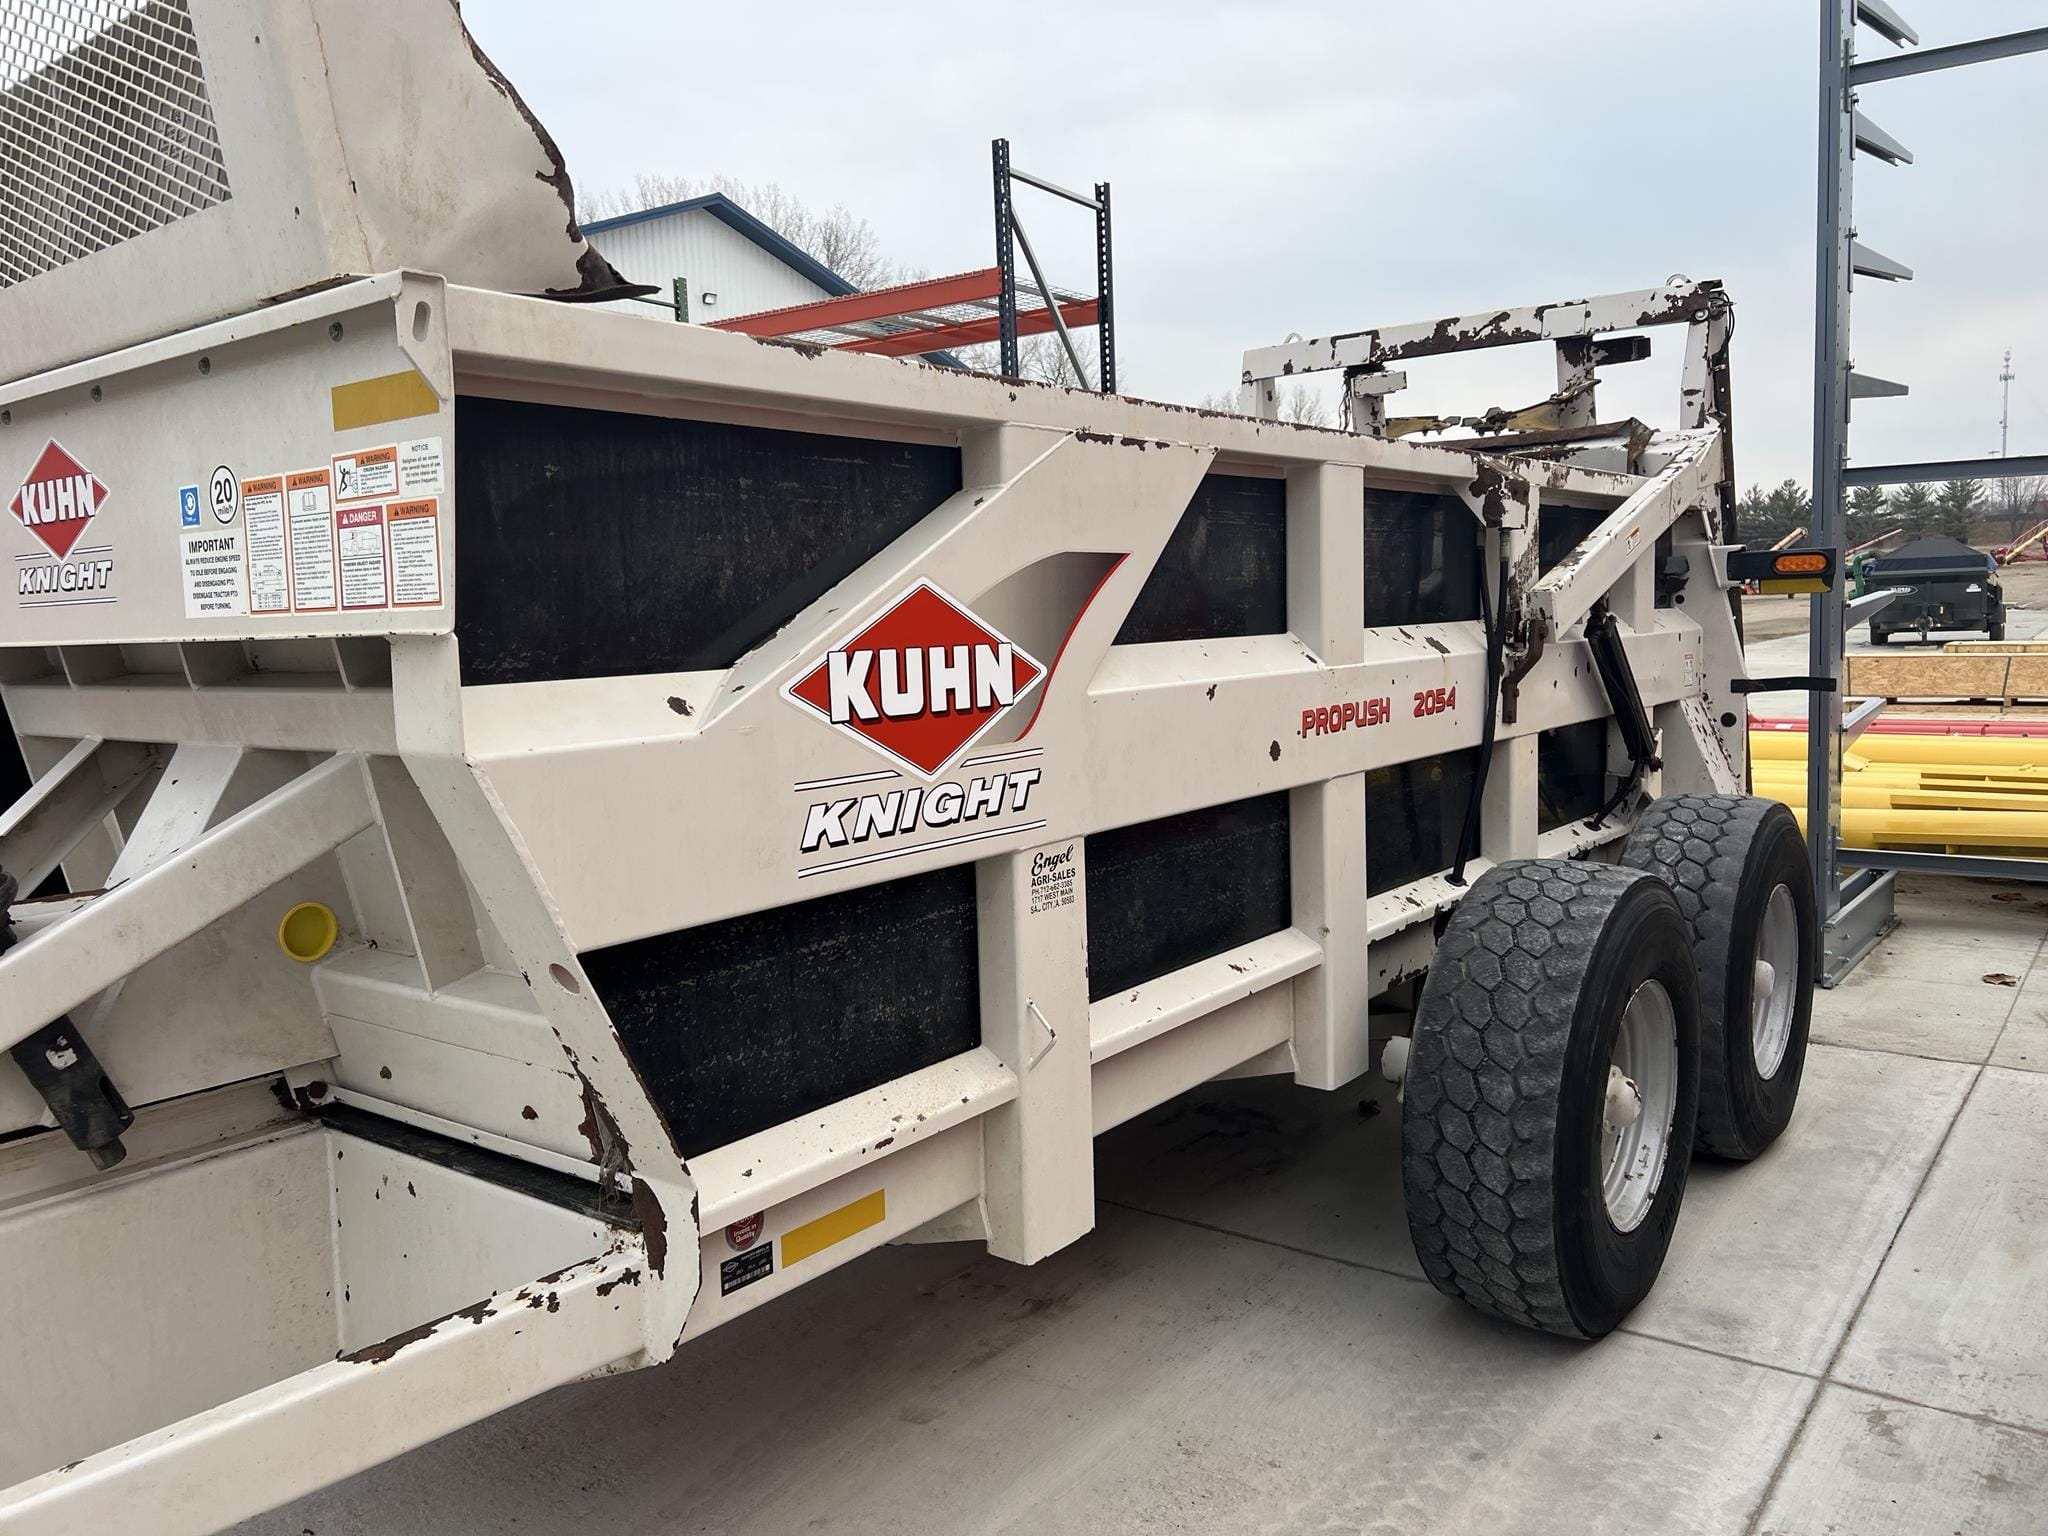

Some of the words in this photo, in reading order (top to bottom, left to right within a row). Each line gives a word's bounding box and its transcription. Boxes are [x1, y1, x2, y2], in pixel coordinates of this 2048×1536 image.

[366, 452, 390, 463] WARNING
[252, 481, 277, 492] WARNING
[298, 473, 323, 486] WARNING
[21, 472, 95, 526] KUHN
[214, 478, 233, 505] 20
[349, 510, 377, 523] DANGER
[400, 504, 430, 516] WARNING
[188, 537, 235, 554] IMPORTANT
[229, 554, 241, 562] SPEED
[18, 560, 113, 595] KNIGHT
[827, 643, 1015, 724] KUHN
[1301, 697, 1391, 738] PROPUSH
[1413, 686, 1457, 718] 2054
[800, 768, 1042, 853] KNIGHT
[1031, 844, 1074, 877] Engel
[1031, 867, 1076, 888] AGRI-SALES
[1043, 889, 1060, 901] WEST
[1060, 886, 1074, 897] MAIN
[1041, 900, 1054, 912] CITY
[736, 1231, 755, 1243] Quality
